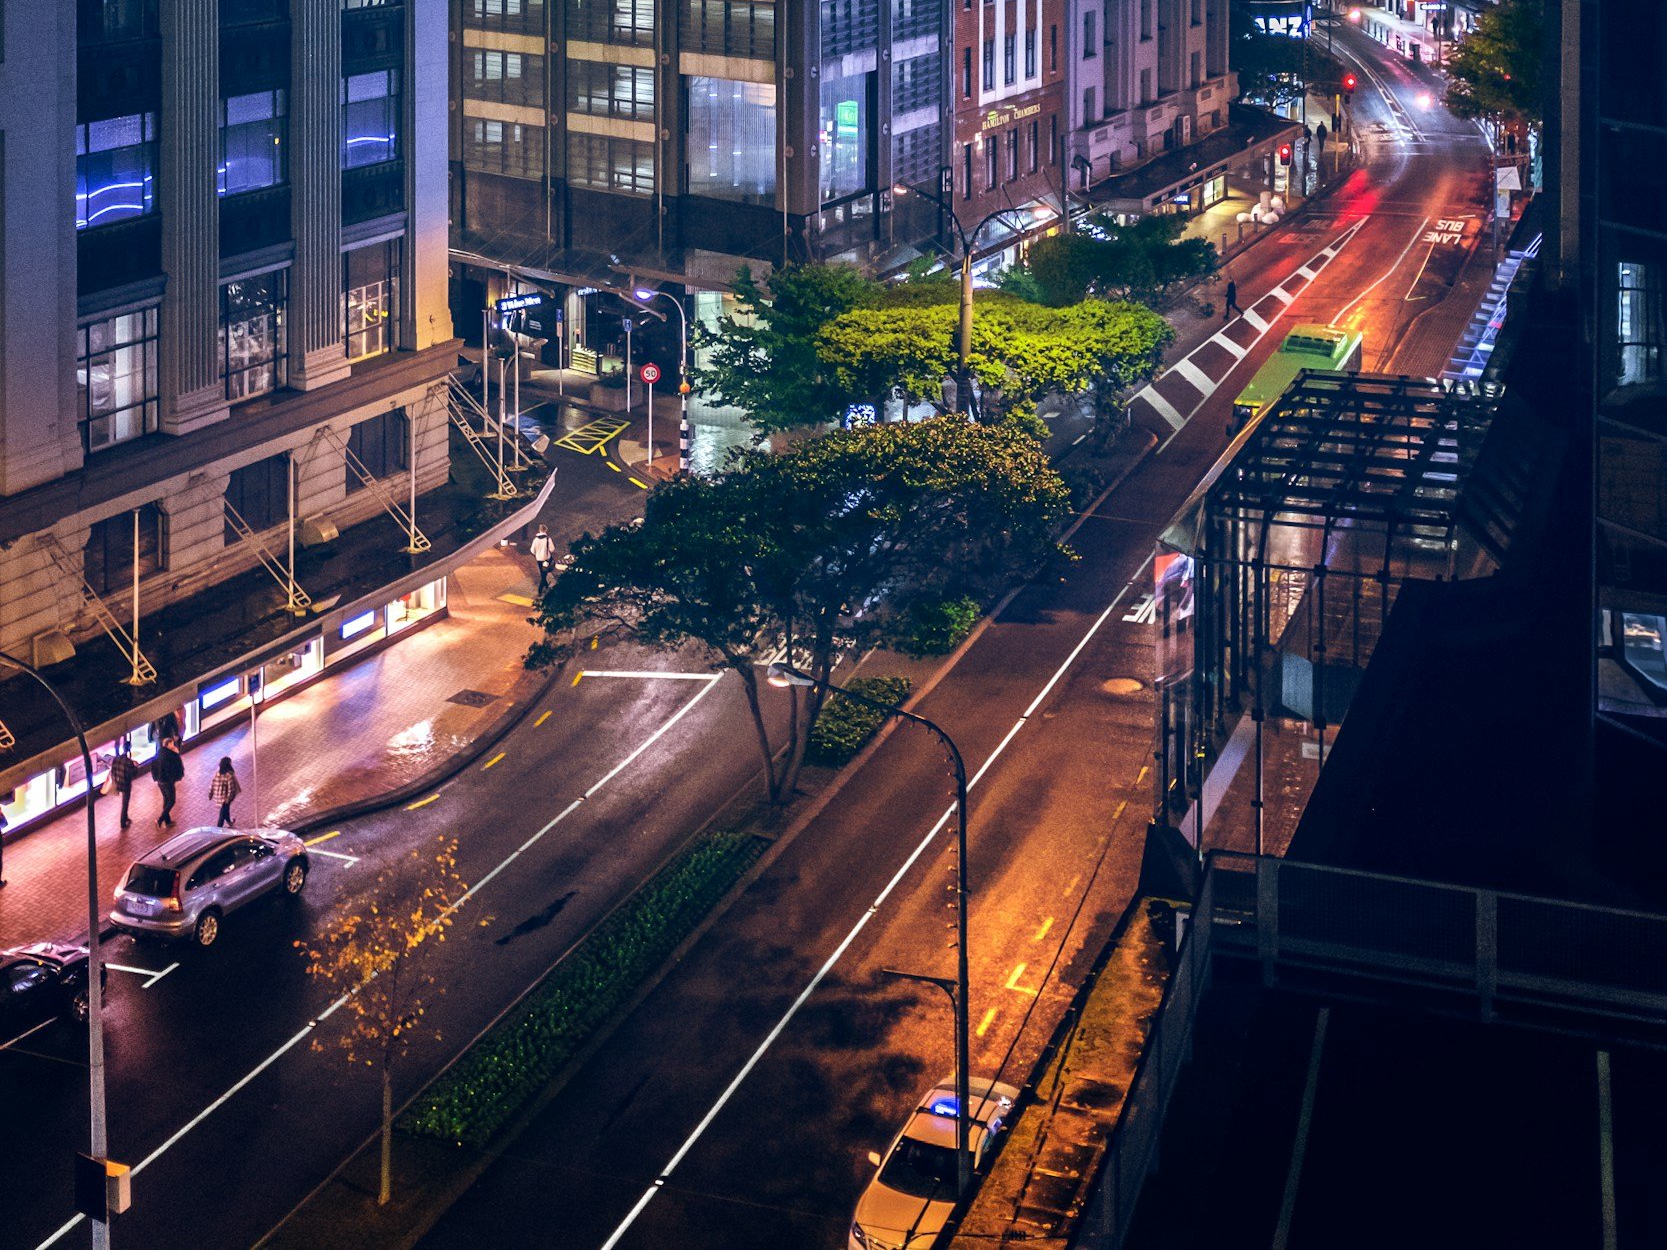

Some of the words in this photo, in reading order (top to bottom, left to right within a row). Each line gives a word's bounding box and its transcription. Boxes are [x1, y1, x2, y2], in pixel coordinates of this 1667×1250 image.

[982, 113, 1010, 131] HAMILTON
[1013, 103, 1041, 119] CHAMBERS
[1435, 219, 1465, 231] BUS
[1421, 231, 1462, 245] LANE
[645, 369, 656, 378] 50
